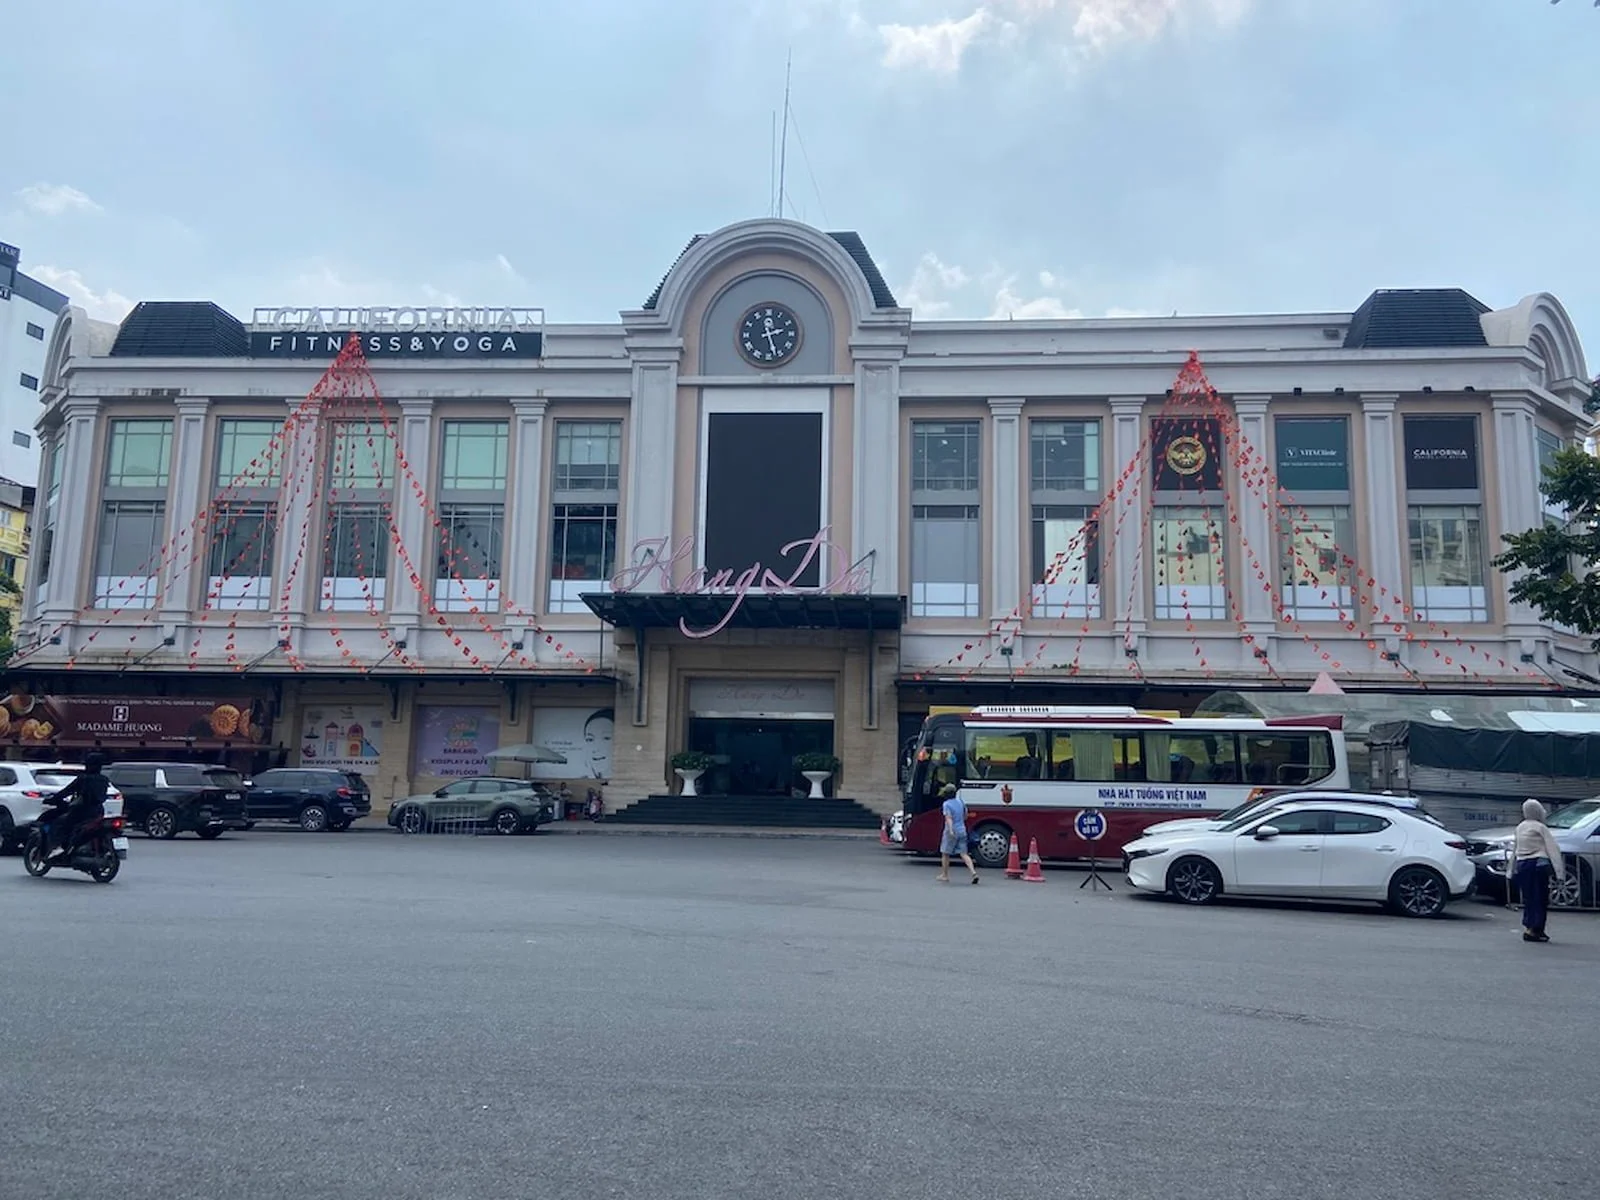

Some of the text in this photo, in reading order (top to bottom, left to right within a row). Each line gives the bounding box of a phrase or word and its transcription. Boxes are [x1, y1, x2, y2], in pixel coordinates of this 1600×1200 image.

[273, 306, 521, 333] CALIFORNIA
[269, 336, 517, 352] FITNSS&YOGA
[76, 722, 122, 731] MADAME
[1186, 790, 1207, 801] NAM
